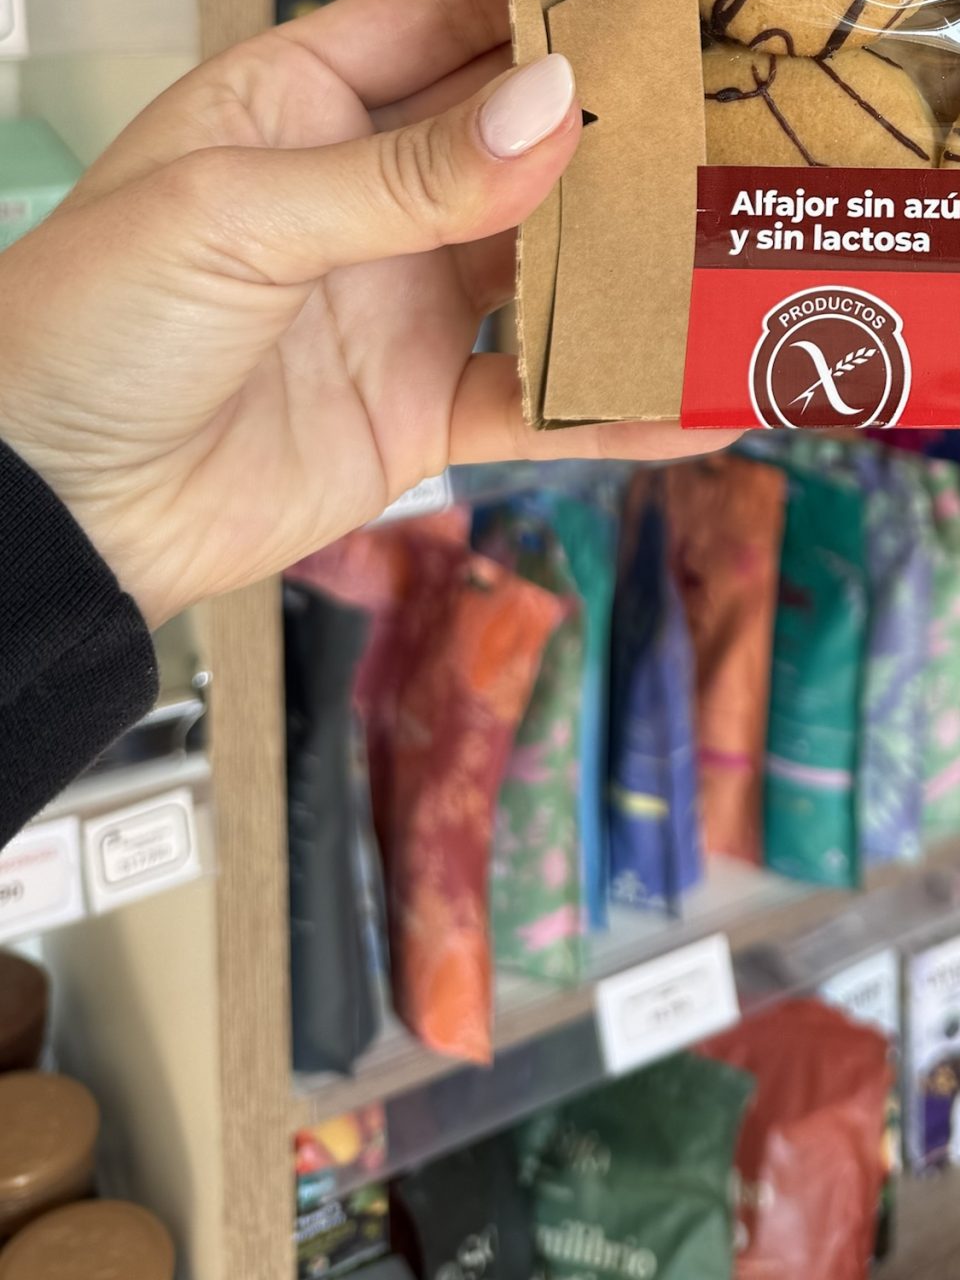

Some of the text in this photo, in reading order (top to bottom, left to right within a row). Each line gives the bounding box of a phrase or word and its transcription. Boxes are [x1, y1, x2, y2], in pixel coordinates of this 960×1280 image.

[730, 188, 839, 223] Alfajor
[847, 189, 895, 218] sin
[728, 221, 931, 256] y sin lactosa
[778, 296, 887, 330] PRODUCTOS
